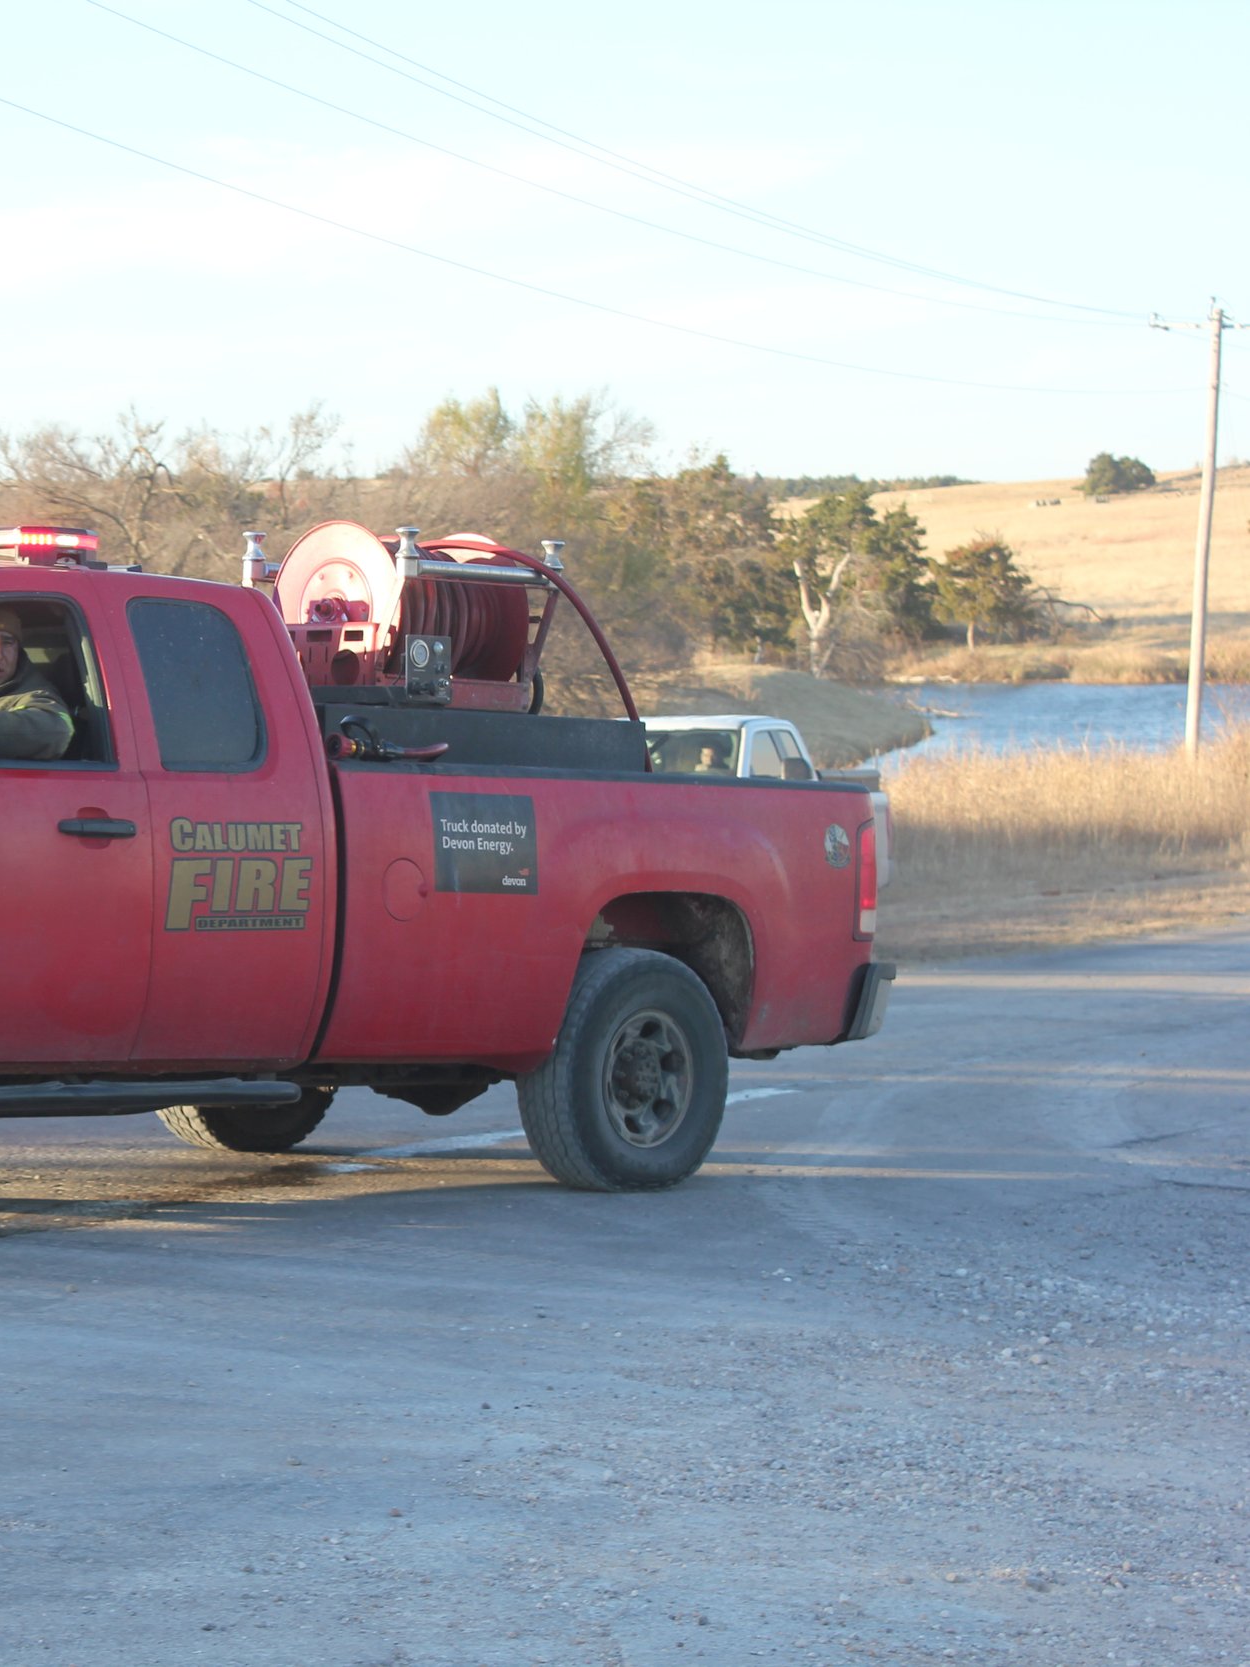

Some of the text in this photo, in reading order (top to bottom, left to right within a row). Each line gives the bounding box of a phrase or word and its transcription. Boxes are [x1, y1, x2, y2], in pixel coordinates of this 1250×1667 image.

[170, 817, 302, 852] CALUMET
[440, 819, 527, 839] Truck donated by
[442, 836, 514, 855] Devon Energy.
[501, 876, 527, 887] devon
[165, 857, 312, 931] FIRE
[197, 917, 303, 929] DEPARTMENT
